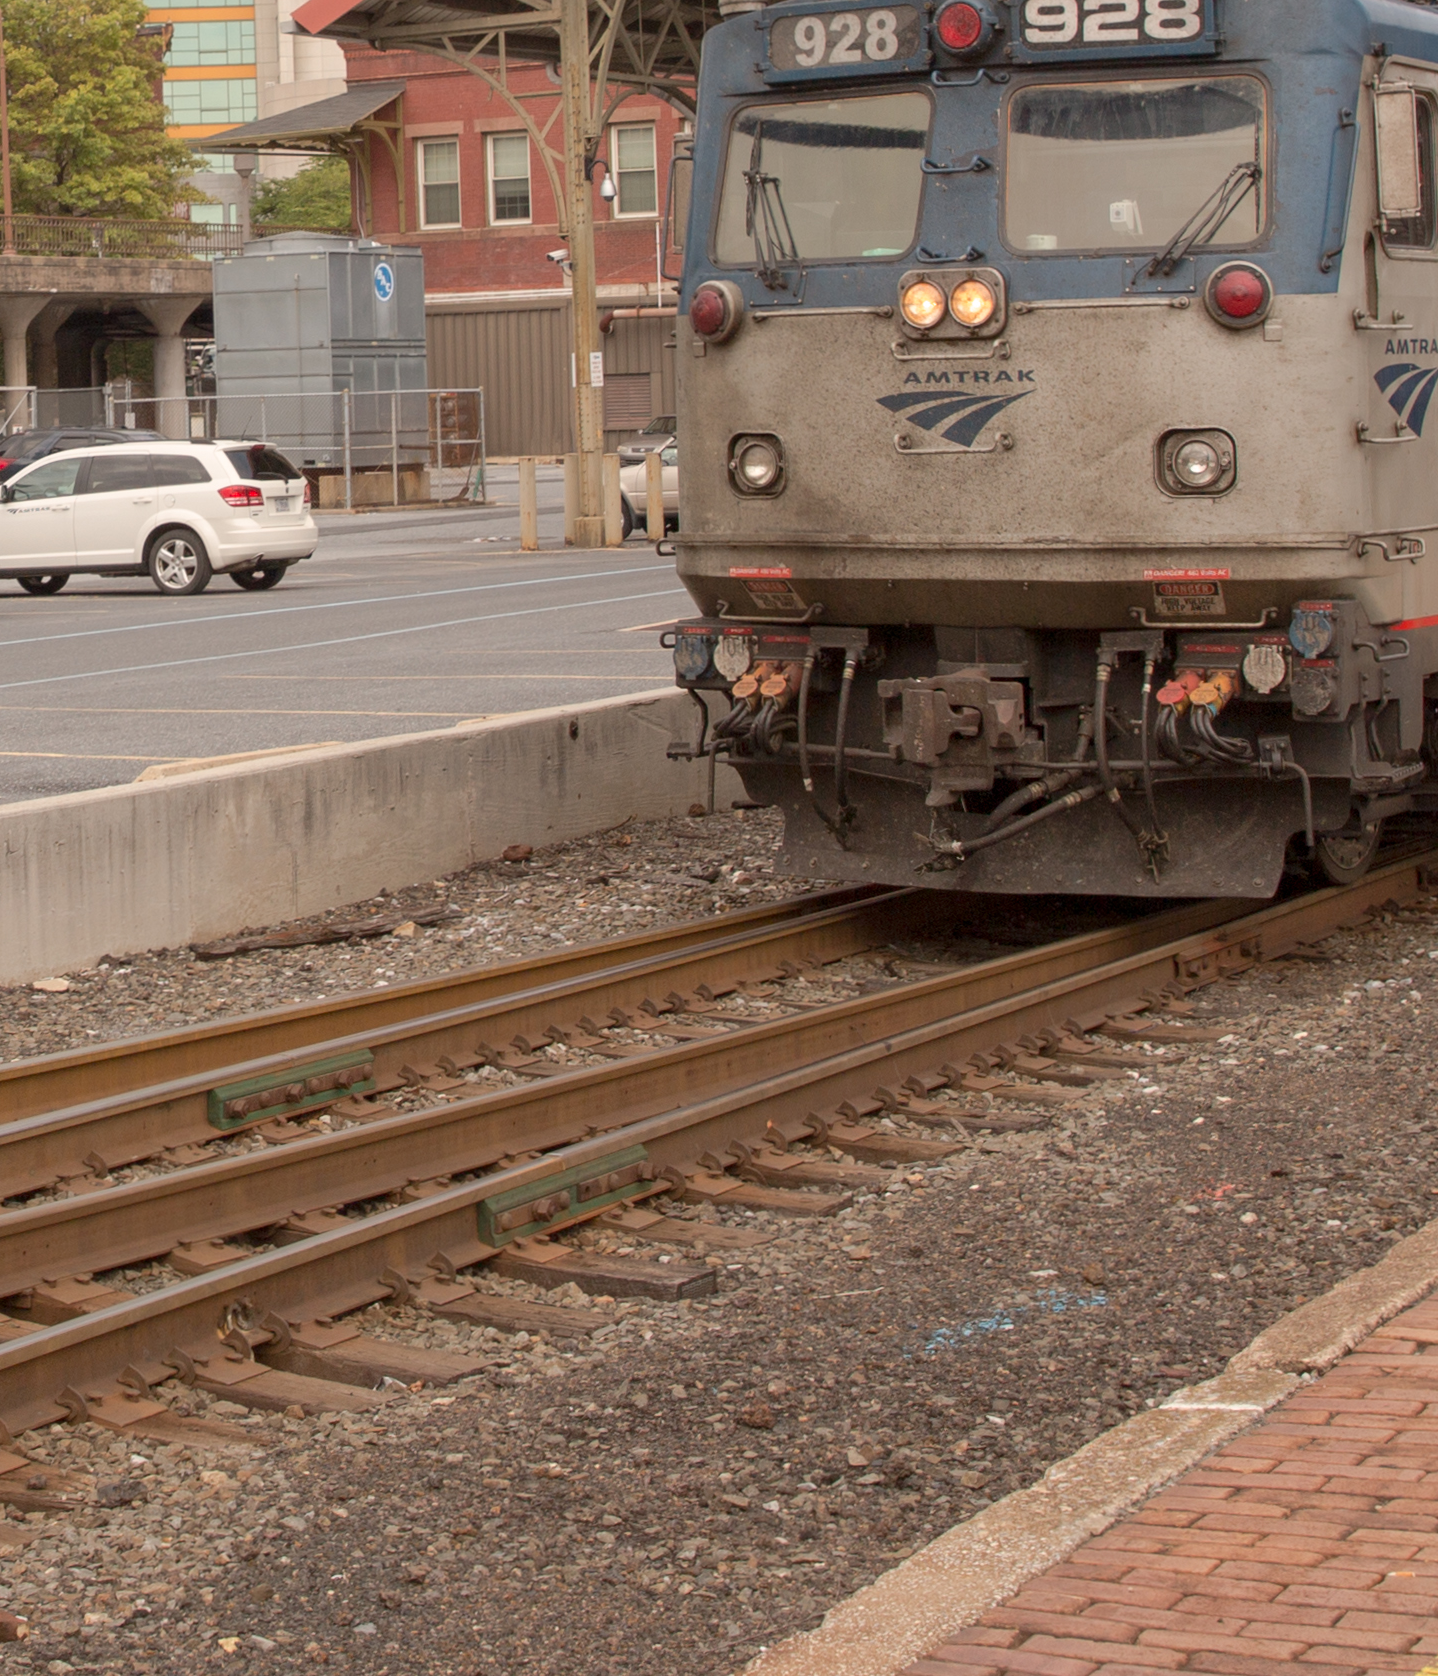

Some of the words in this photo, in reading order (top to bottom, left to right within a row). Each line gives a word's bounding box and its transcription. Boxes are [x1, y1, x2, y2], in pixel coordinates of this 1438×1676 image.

[794, 9, 899, 67] 928
[904, 369, 1035, 385] AMTRAK
[1165, 585, 1210, 594] DANGER
